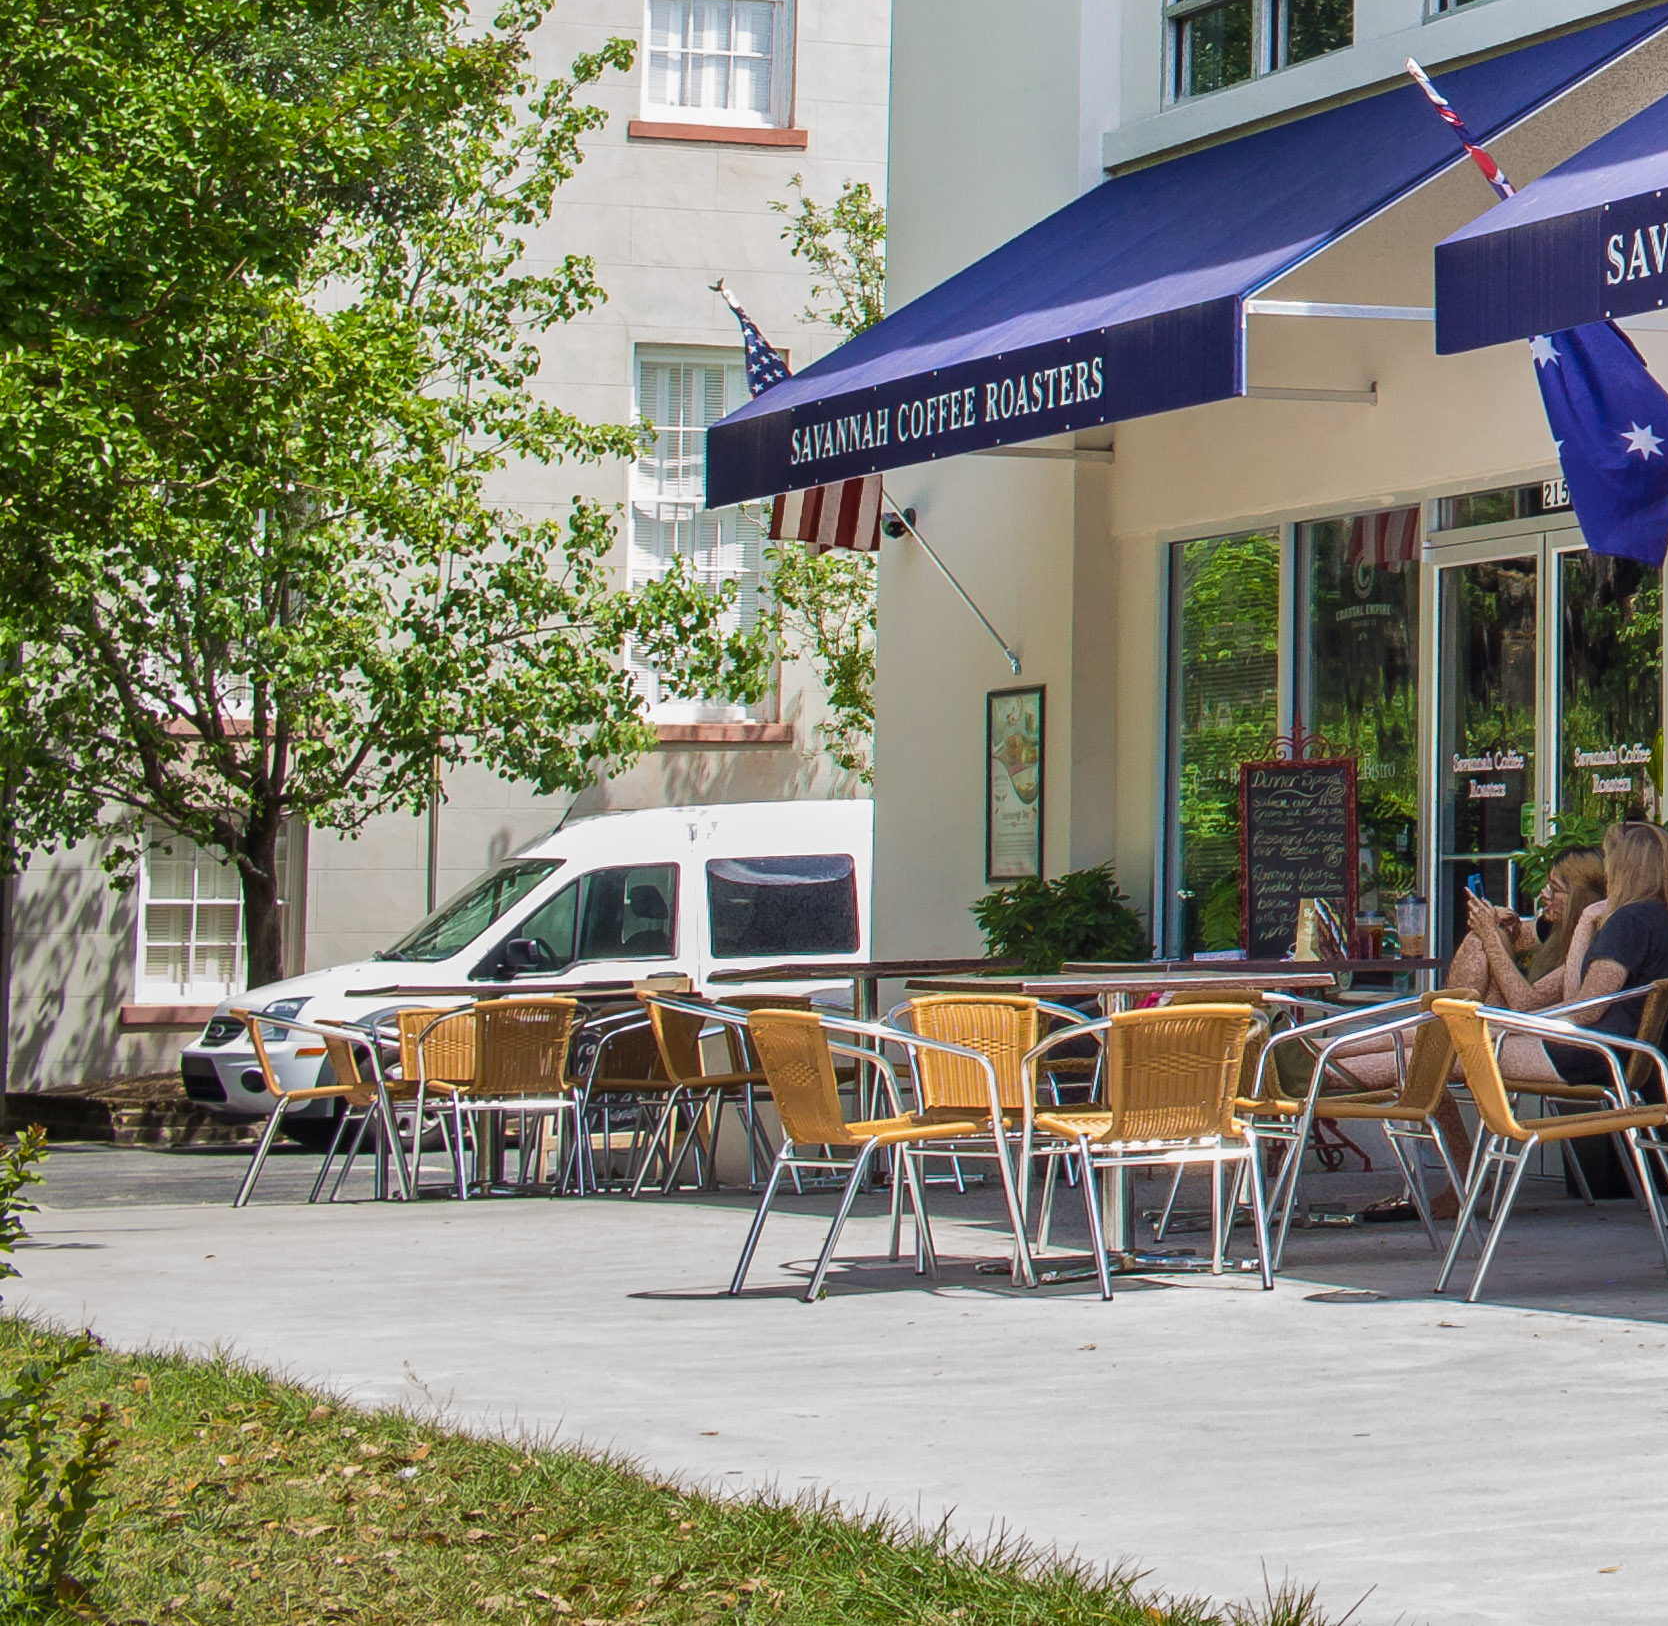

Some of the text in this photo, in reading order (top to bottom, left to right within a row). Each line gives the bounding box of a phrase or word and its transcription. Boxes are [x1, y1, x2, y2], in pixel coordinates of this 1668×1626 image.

[790, 357, 1104, 465] SAVANNAH COFFEE ROASTERS
[1543, 478, 1569, 508] 215
[1494, 749, 1526, 771] Coffee
[1618, 741, 1651, 765] Coffee
